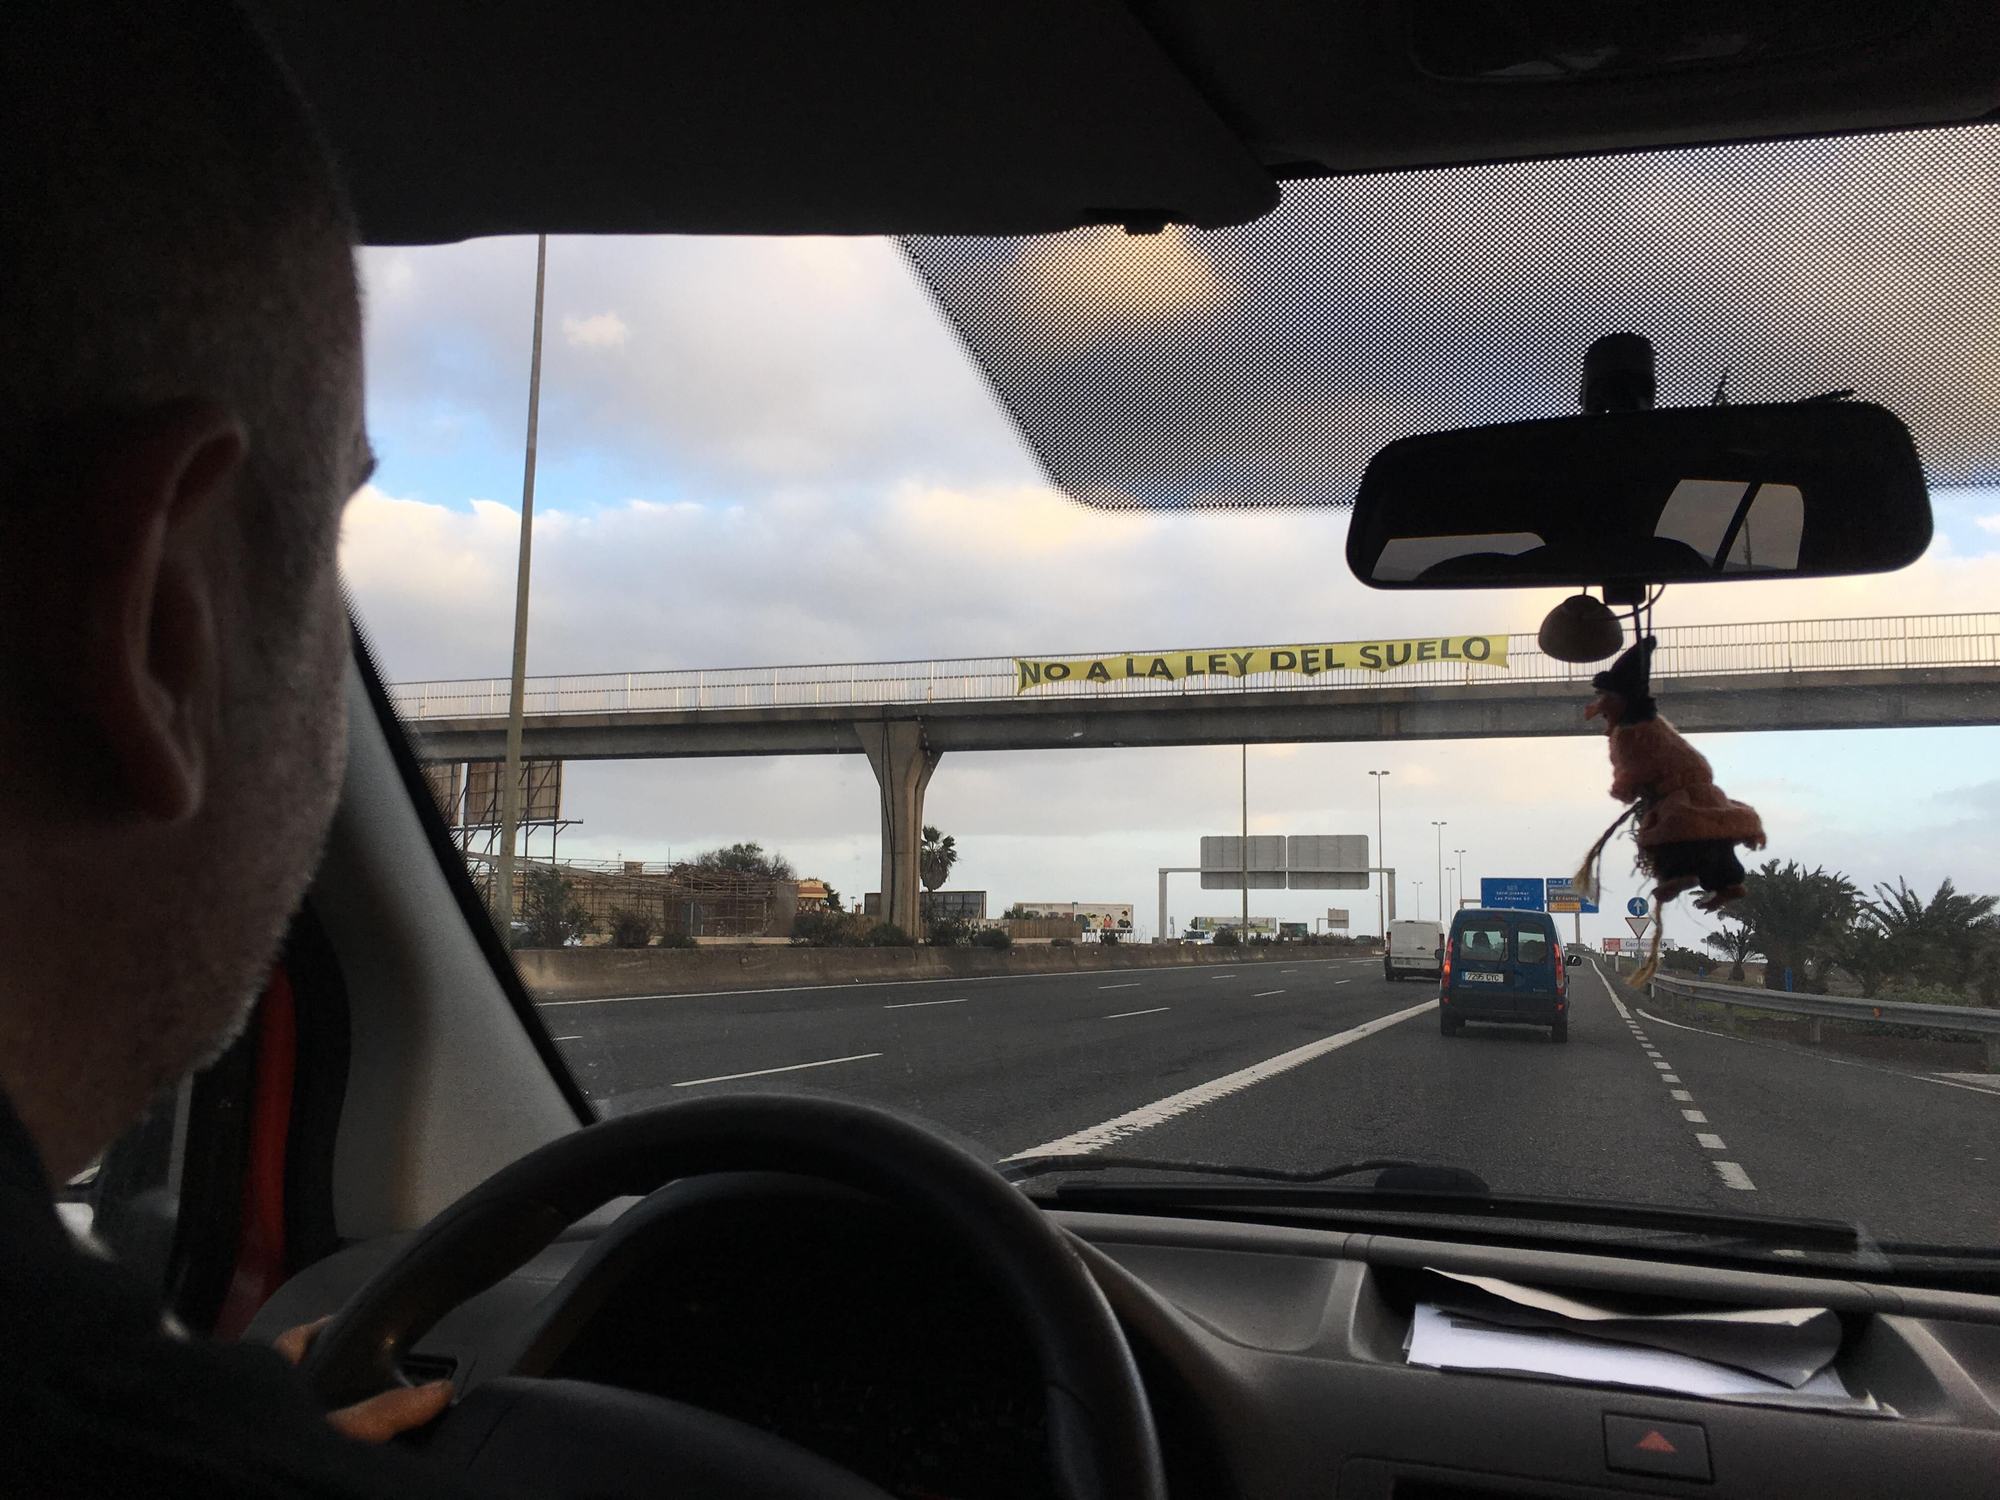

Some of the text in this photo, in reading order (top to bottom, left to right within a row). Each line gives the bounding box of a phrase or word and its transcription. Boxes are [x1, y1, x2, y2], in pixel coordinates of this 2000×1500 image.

[1019, 637, 1491, 688] NO A LA LEY DEL SUELO
[1486, 973, 1500, 982] CYC
